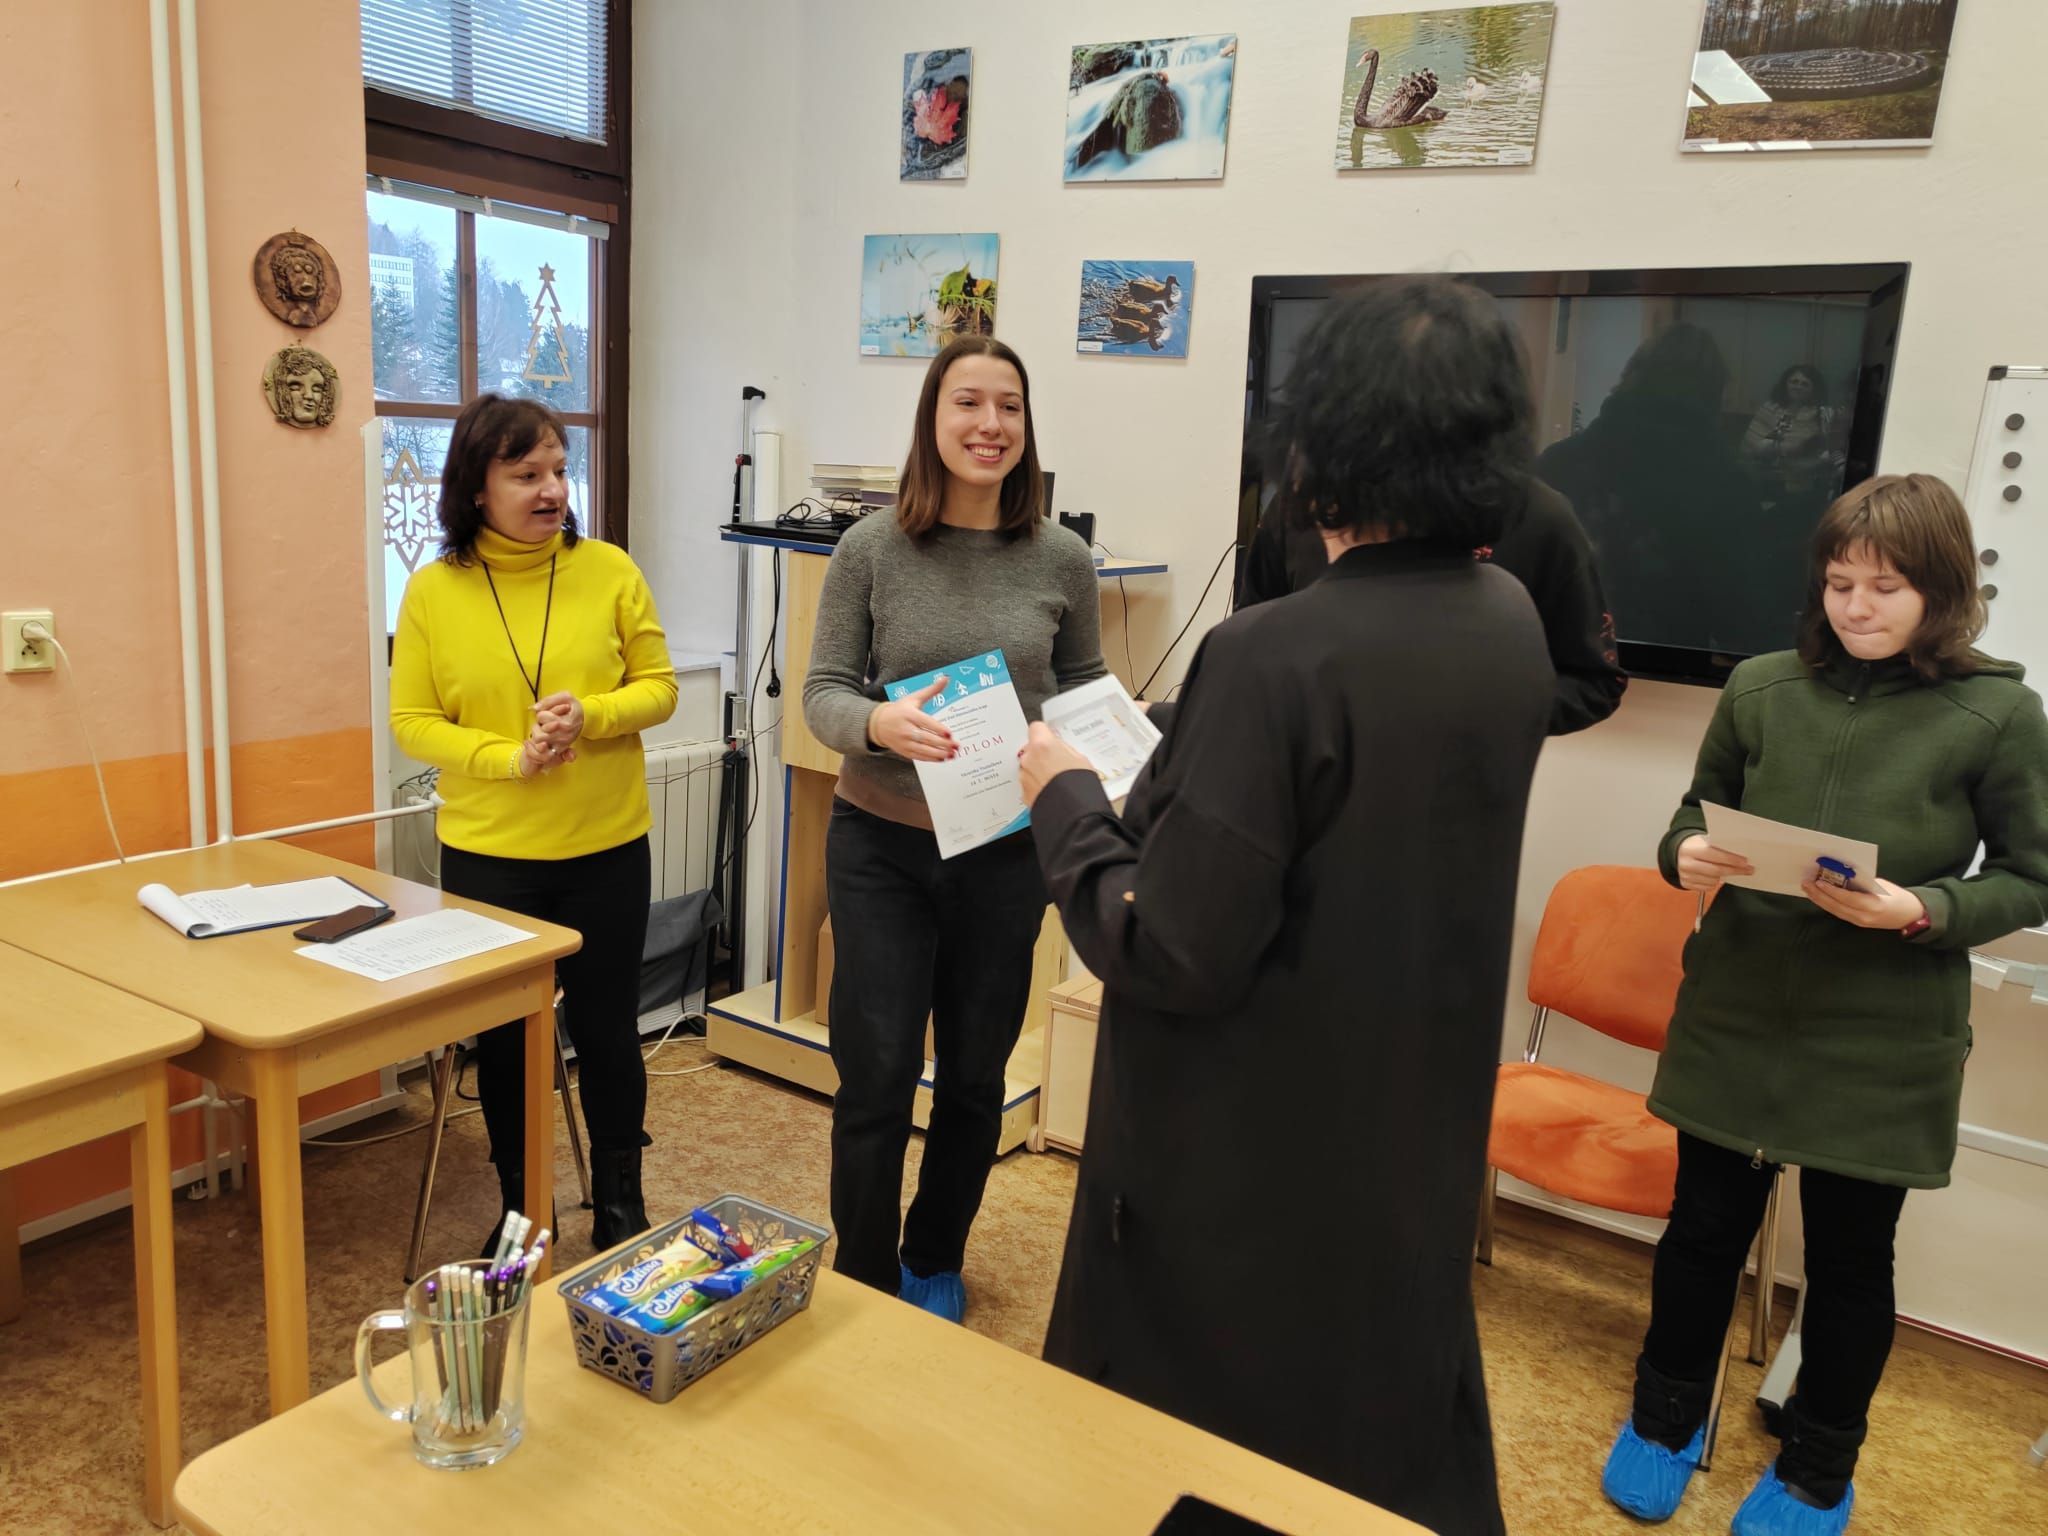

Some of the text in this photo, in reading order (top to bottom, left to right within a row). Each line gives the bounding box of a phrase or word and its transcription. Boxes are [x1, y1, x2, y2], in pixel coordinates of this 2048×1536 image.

[957, 735, 1004, 757] IPLOM
[620, 1260, 661, 1293] Delissa
[652, 1281, 693, 1314] Delissa
